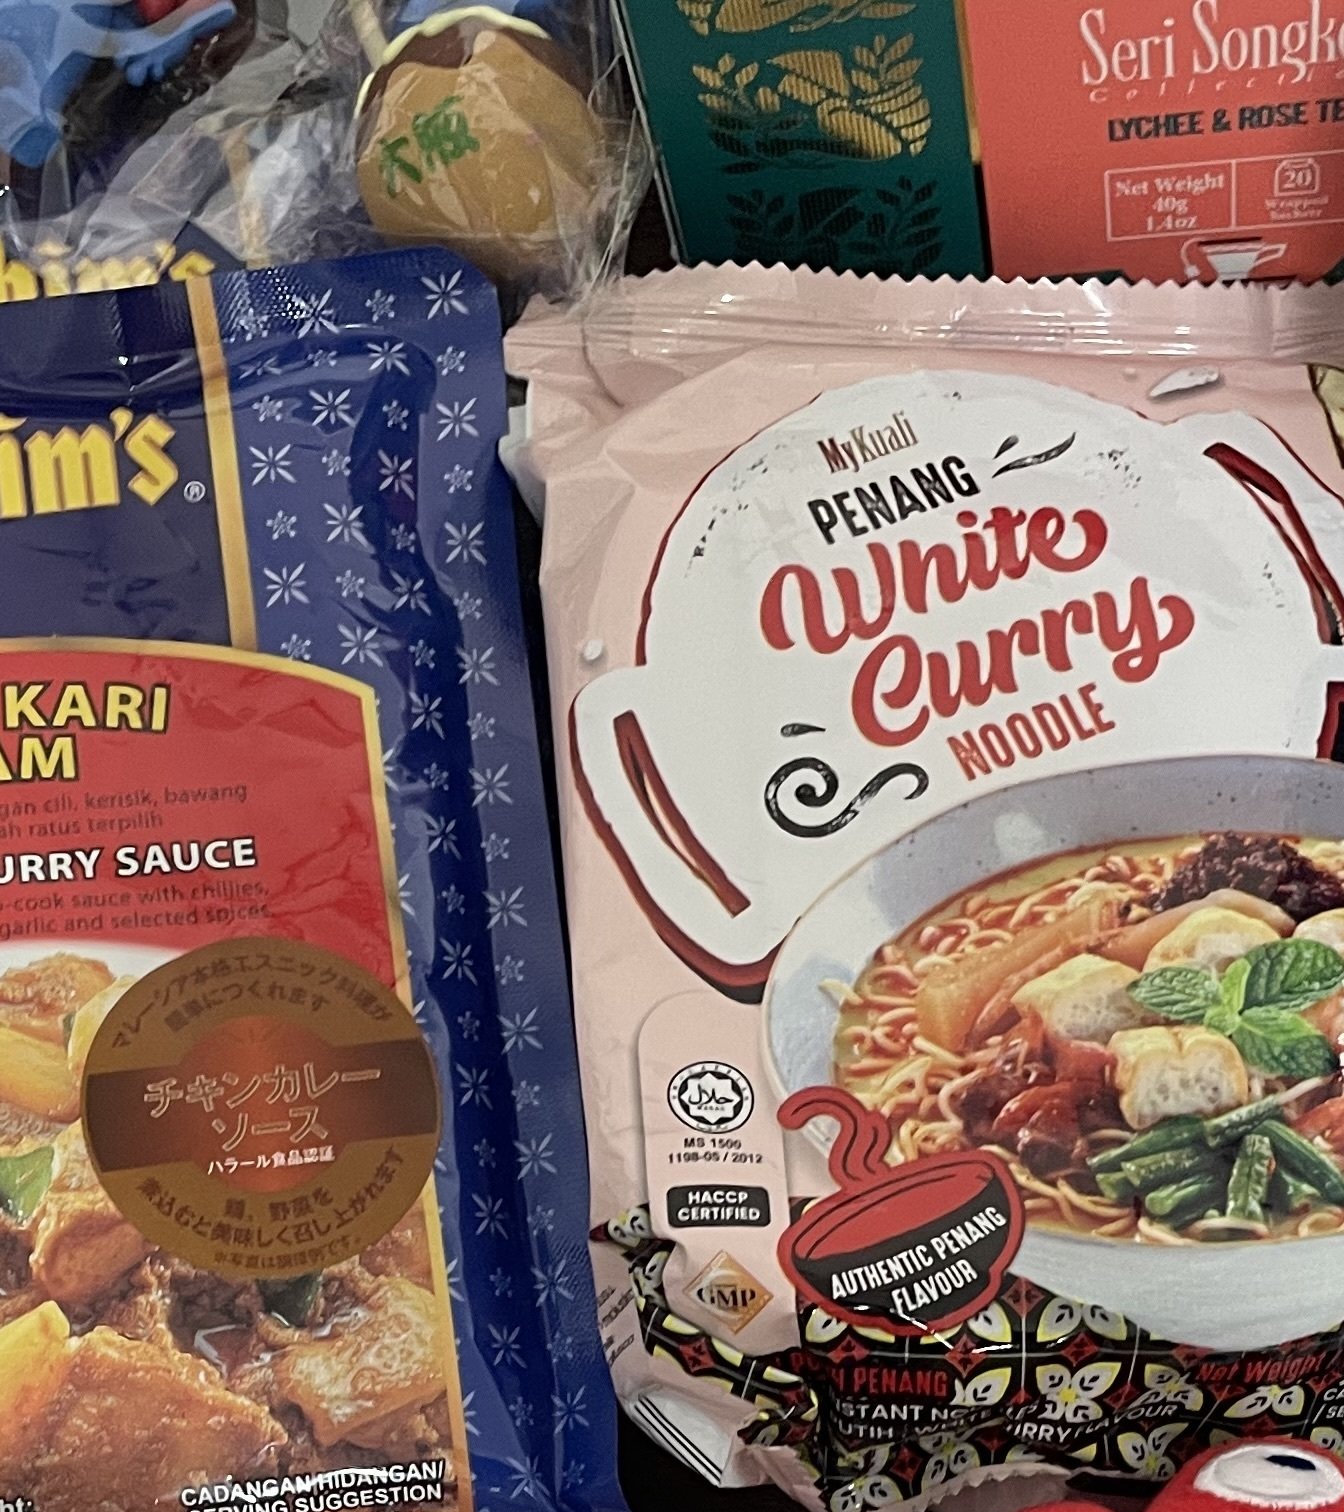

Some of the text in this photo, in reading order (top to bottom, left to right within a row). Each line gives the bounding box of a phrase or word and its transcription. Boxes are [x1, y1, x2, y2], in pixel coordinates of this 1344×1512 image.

[1078, 6, 1176, 89] Seri
[1108, 110, 1205, 142] LYCHEE
[1212, 108, 1233, 133] &
[1239, 101, 1309, 131] ROSE
[1155, 173, 1225, 196] Weight
[1282, 169, 1313, 189] 20
[816, 411, 919, 475] MyKuali
[806, 455, 982, 545] PENANG
[759, 504, 1109, 656] White
[850, 575, 1196, 748] Curry
[4, 681, 170, 732] KARI
[946, 681, 1116, 782] NOODLE
[114, 837, 257, 878] SAUCE
[135, 882, 184, 904] with
[64, 912, 105, 933] and
[111, 905, 199, 930] selected
[143, 1061, 382, 1119] チキンカレー
[212, 1105, 330, 1153] ソース
[676, 1206, 761, 1222] CERTIFIED
[687, 1189, 749, 1206] HACCP
[829, 1204, 1007, 1301] AUTHENTIC PENANG
[889, 1258, 980, 1316] FLAVOUR
[853, 1367, 950, 1400] PENANG
